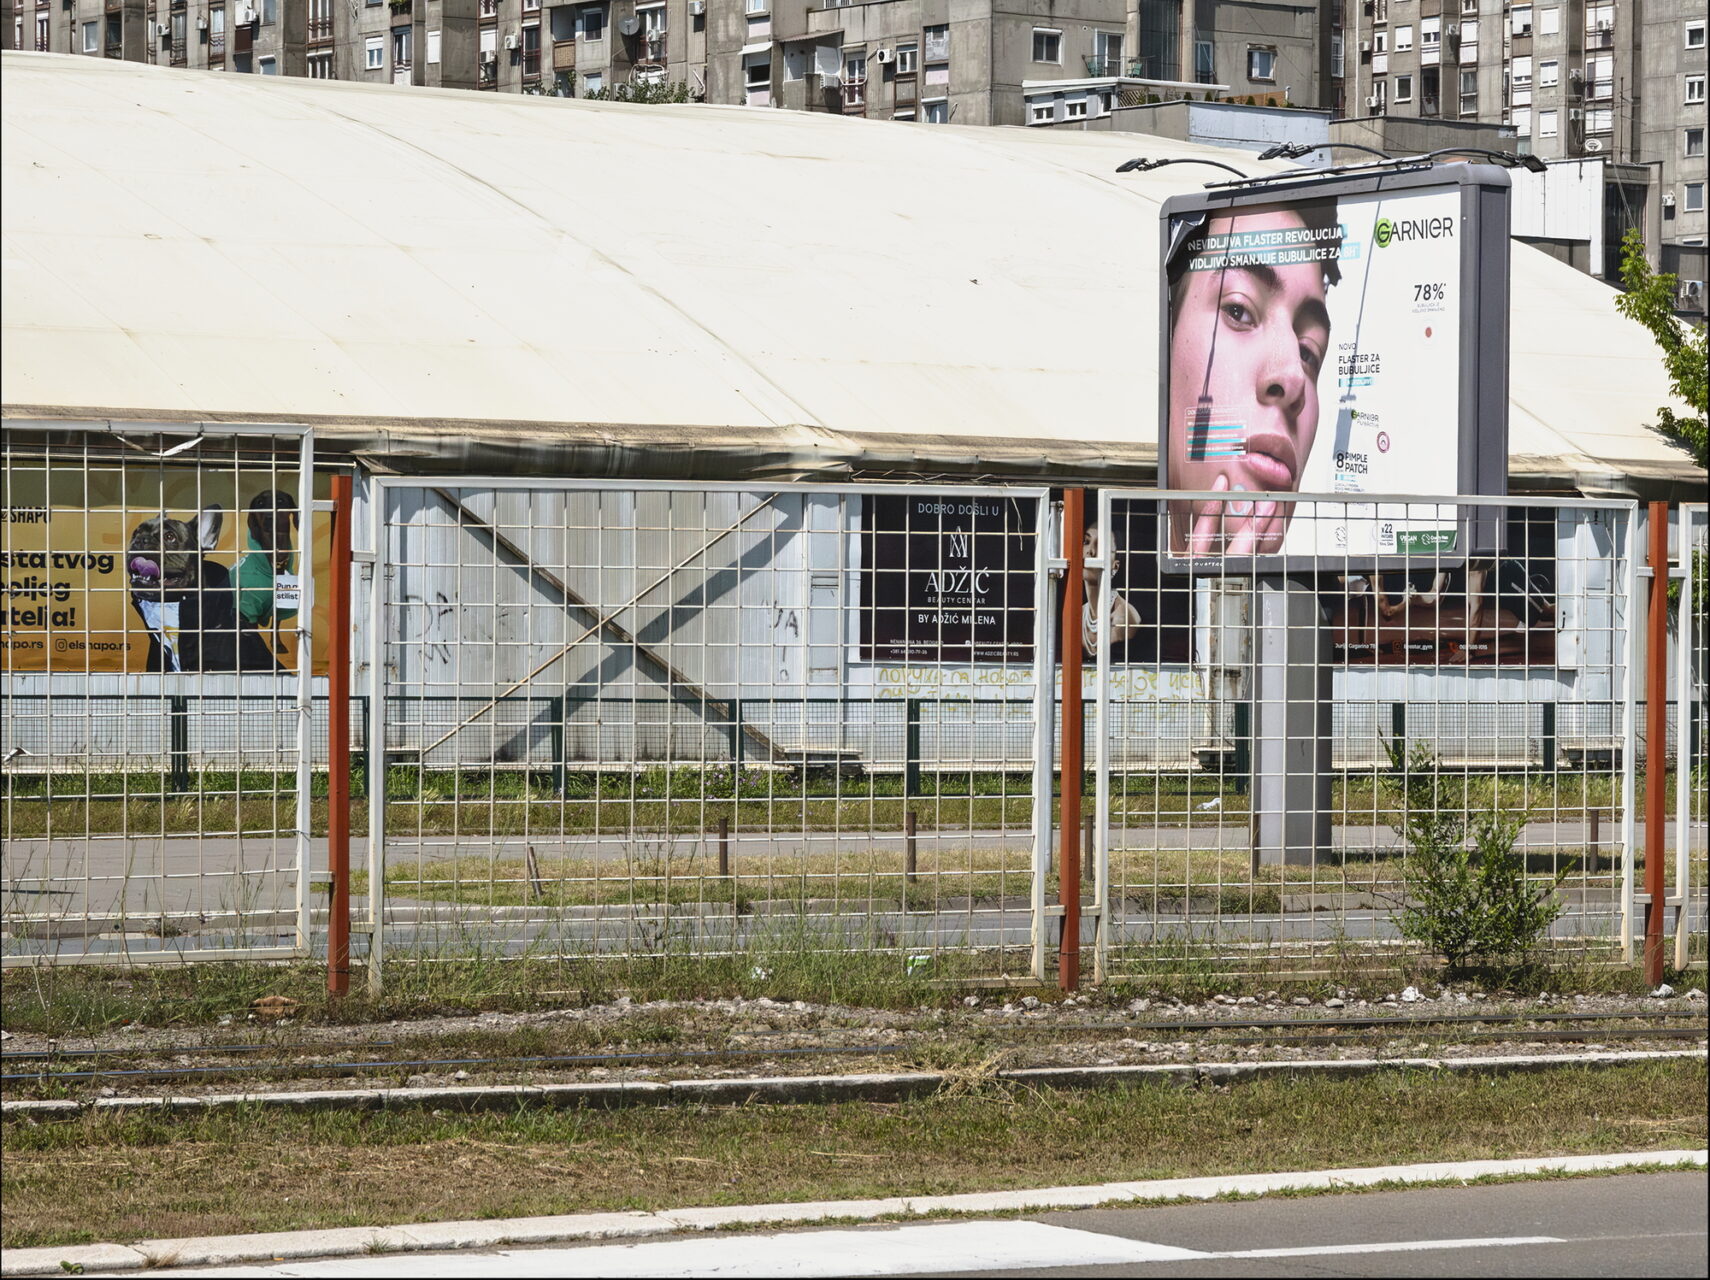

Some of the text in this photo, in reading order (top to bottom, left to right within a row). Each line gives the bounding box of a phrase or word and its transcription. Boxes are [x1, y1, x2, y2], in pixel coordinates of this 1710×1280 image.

[1187, 226, 1343, 251] NEVIDLJIVA FLASTER REVOLUCIJA
[1377, 217, 1454, 244] GARNIER
[1189, 255, 1229, 270] VIDLJIVO
[1230, 252, 1277, 267] SMANJUJE
[1278, 248, 1327, 263] BUBULJICE
[1328, 246, 1341, 259] ZA
[1338, 353, 1381, 364] FLASTER ZA
[1338, 364, 1381, 375] BUBULJICE
[1345, 451, 1368, 463] PIMPLE
[1345, 463, 1368, 474] PATCH
[918, 502, 999, 516] DOBRO DOŠLI U
[51, 552, 114, 574] tvog
[1, 576, 71, 602] oljeg
[1, 606, 76, 629] telja!
[918, 614, 929, 623] BY
